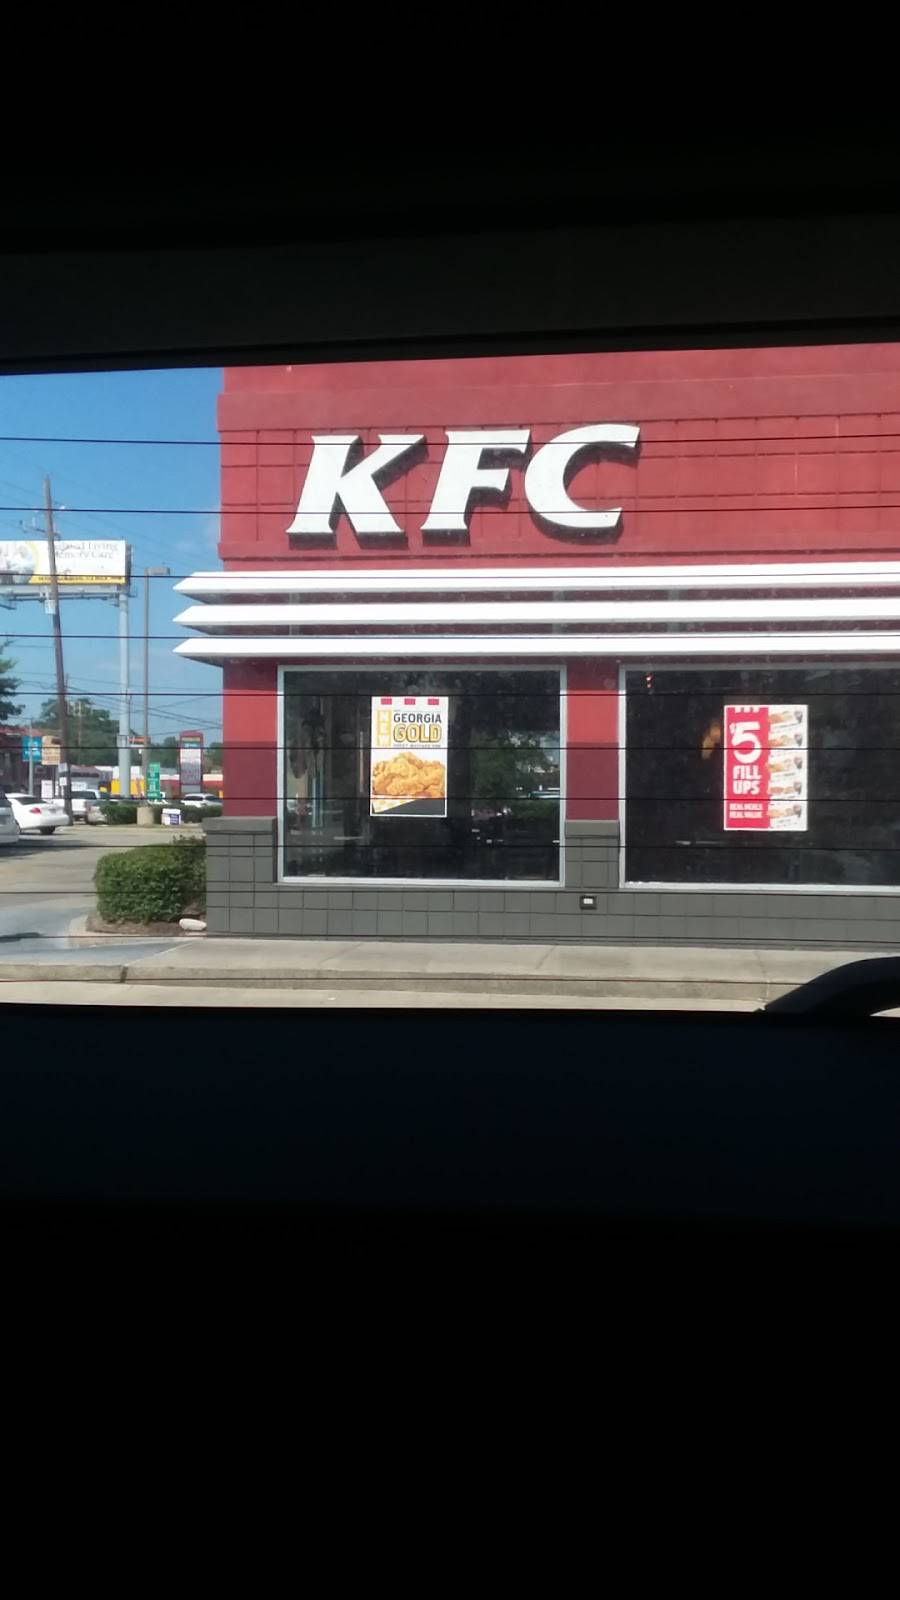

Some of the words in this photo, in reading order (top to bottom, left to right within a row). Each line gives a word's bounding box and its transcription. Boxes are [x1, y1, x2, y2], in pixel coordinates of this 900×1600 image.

[286, 424, 641, 543] KFC
[393, 713, 442, 723] GEORGIA
[393, 723, 442, 743] GOLD
[733, 765, 762, 780] FILL
[733, 780, 760, 794] UPS
